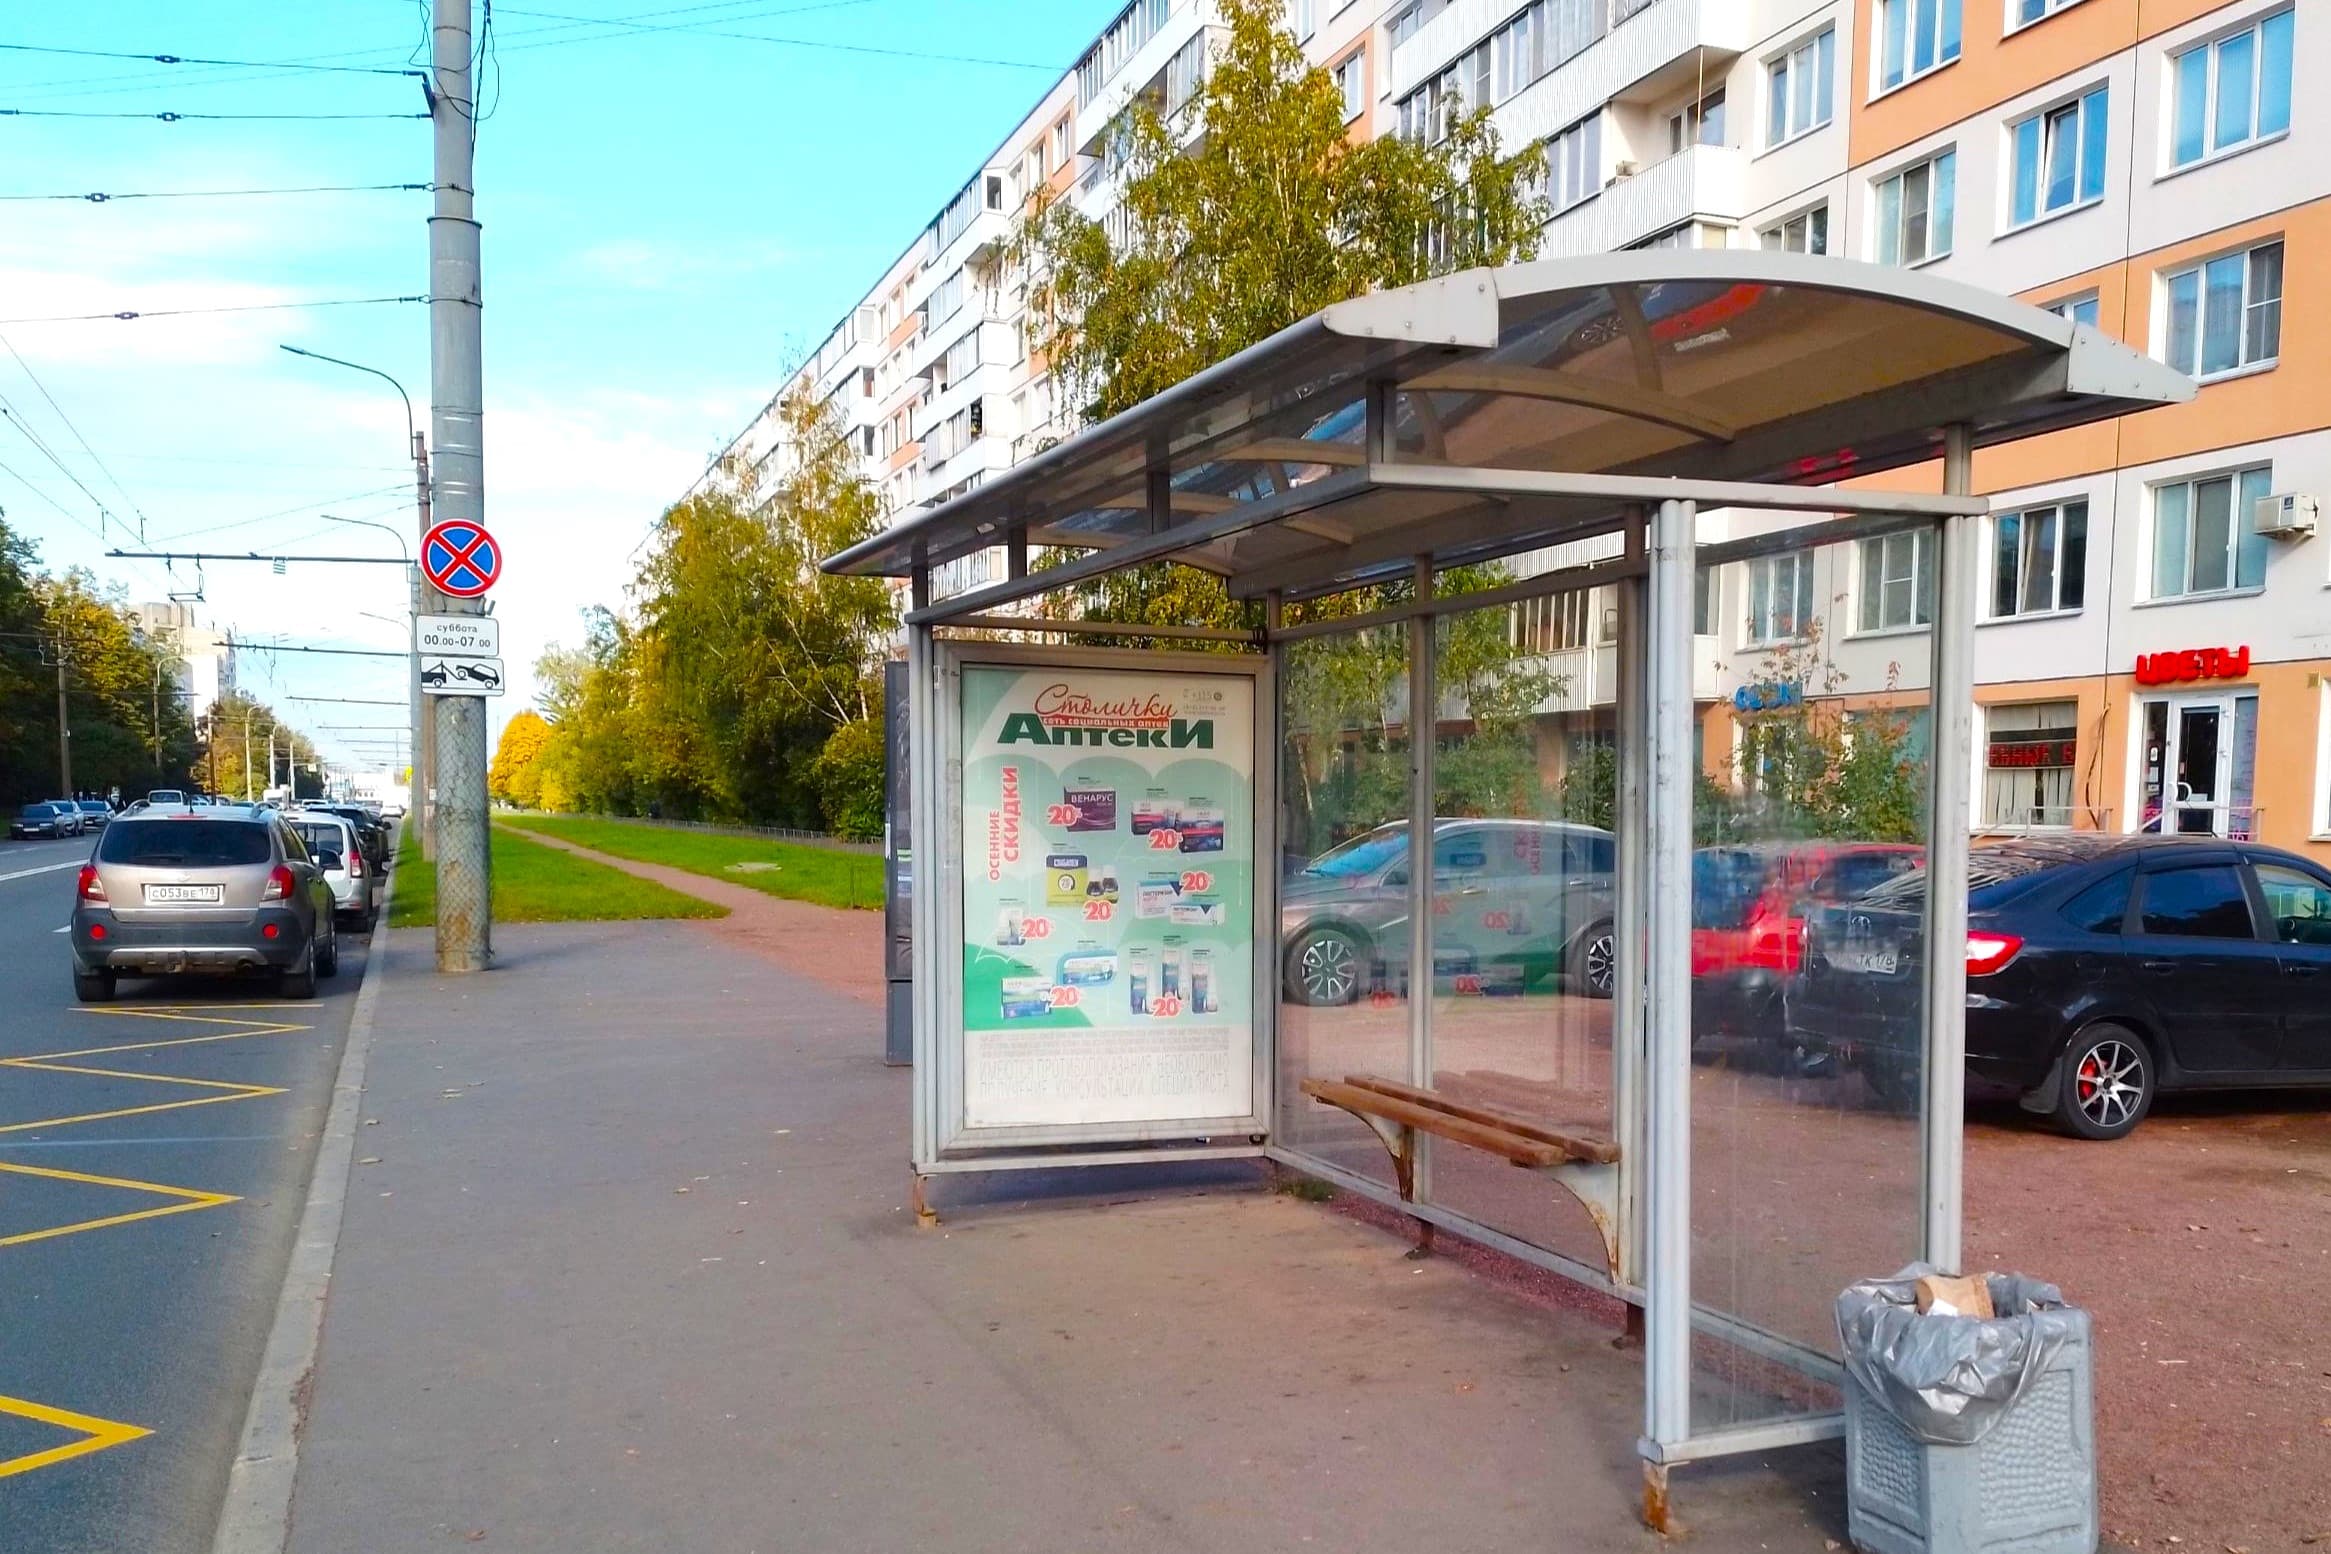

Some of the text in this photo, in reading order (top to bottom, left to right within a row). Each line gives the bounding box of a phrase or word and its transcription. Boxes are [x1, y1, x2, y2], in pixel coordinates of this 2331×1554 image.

[436, 624, 478, 633] суббота
[2136, 645, 2250, 685] ЦВЕТЫ
[1034, 683, 1178, 717] Столички
[1043, 717, 1066, 726] сеть
[1068, 718, 1135, 728] социальных
[1003, 767, 1021, 862] СКИДКИ
[1071, 793, 1114, 803] ВЕНАРУС
[989, 809, 1000, 881] ОСЕННИЕ
